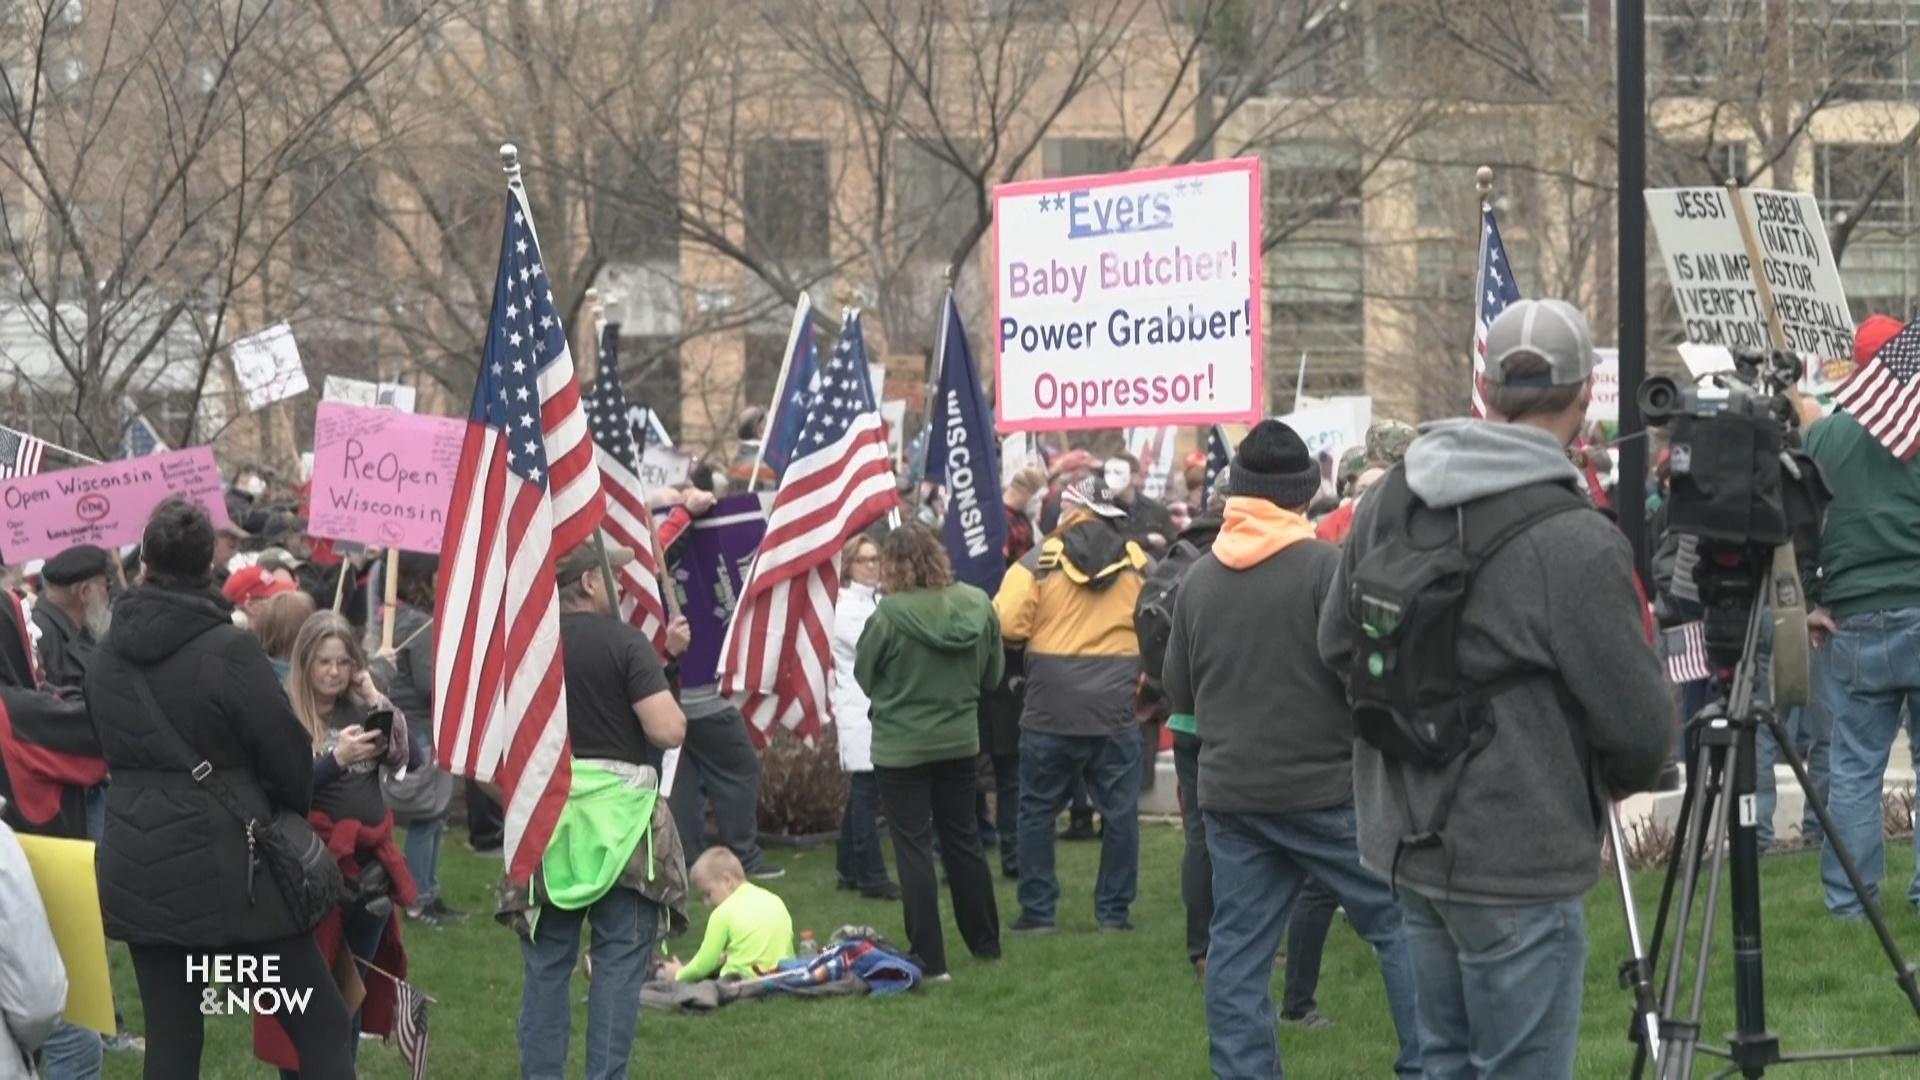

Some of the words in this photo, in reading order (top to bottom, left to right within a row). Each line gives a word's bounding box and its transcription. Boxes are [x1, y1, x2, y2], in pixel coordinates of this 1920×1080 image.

[1675, 191, 1726, 219] JESSI
[1754, 193, 1802, 224] EBBEN
[1758, 219, 1819, 267] (NATTA)
[1009, 258, 1087, 303] Baby
[1100, 240, 1238, 290] Butcher!
[1673, 252, 1694, 280] IS
[1696, 254, 1721, 281] AN
[1000, 316, 1097, 353] Power
[1107, 298, 1251, 347] Grabber!
[1034, 363, 1215, 418] Oppressor!
[344, 438, 438, 493] ReOpen
[5, 486, 50, 510] Open
[57, 469, 152, 495] Wisconsin
[329, 487, 442, 523] Wisconsin
[1744, 798, 1753, 822] 1
